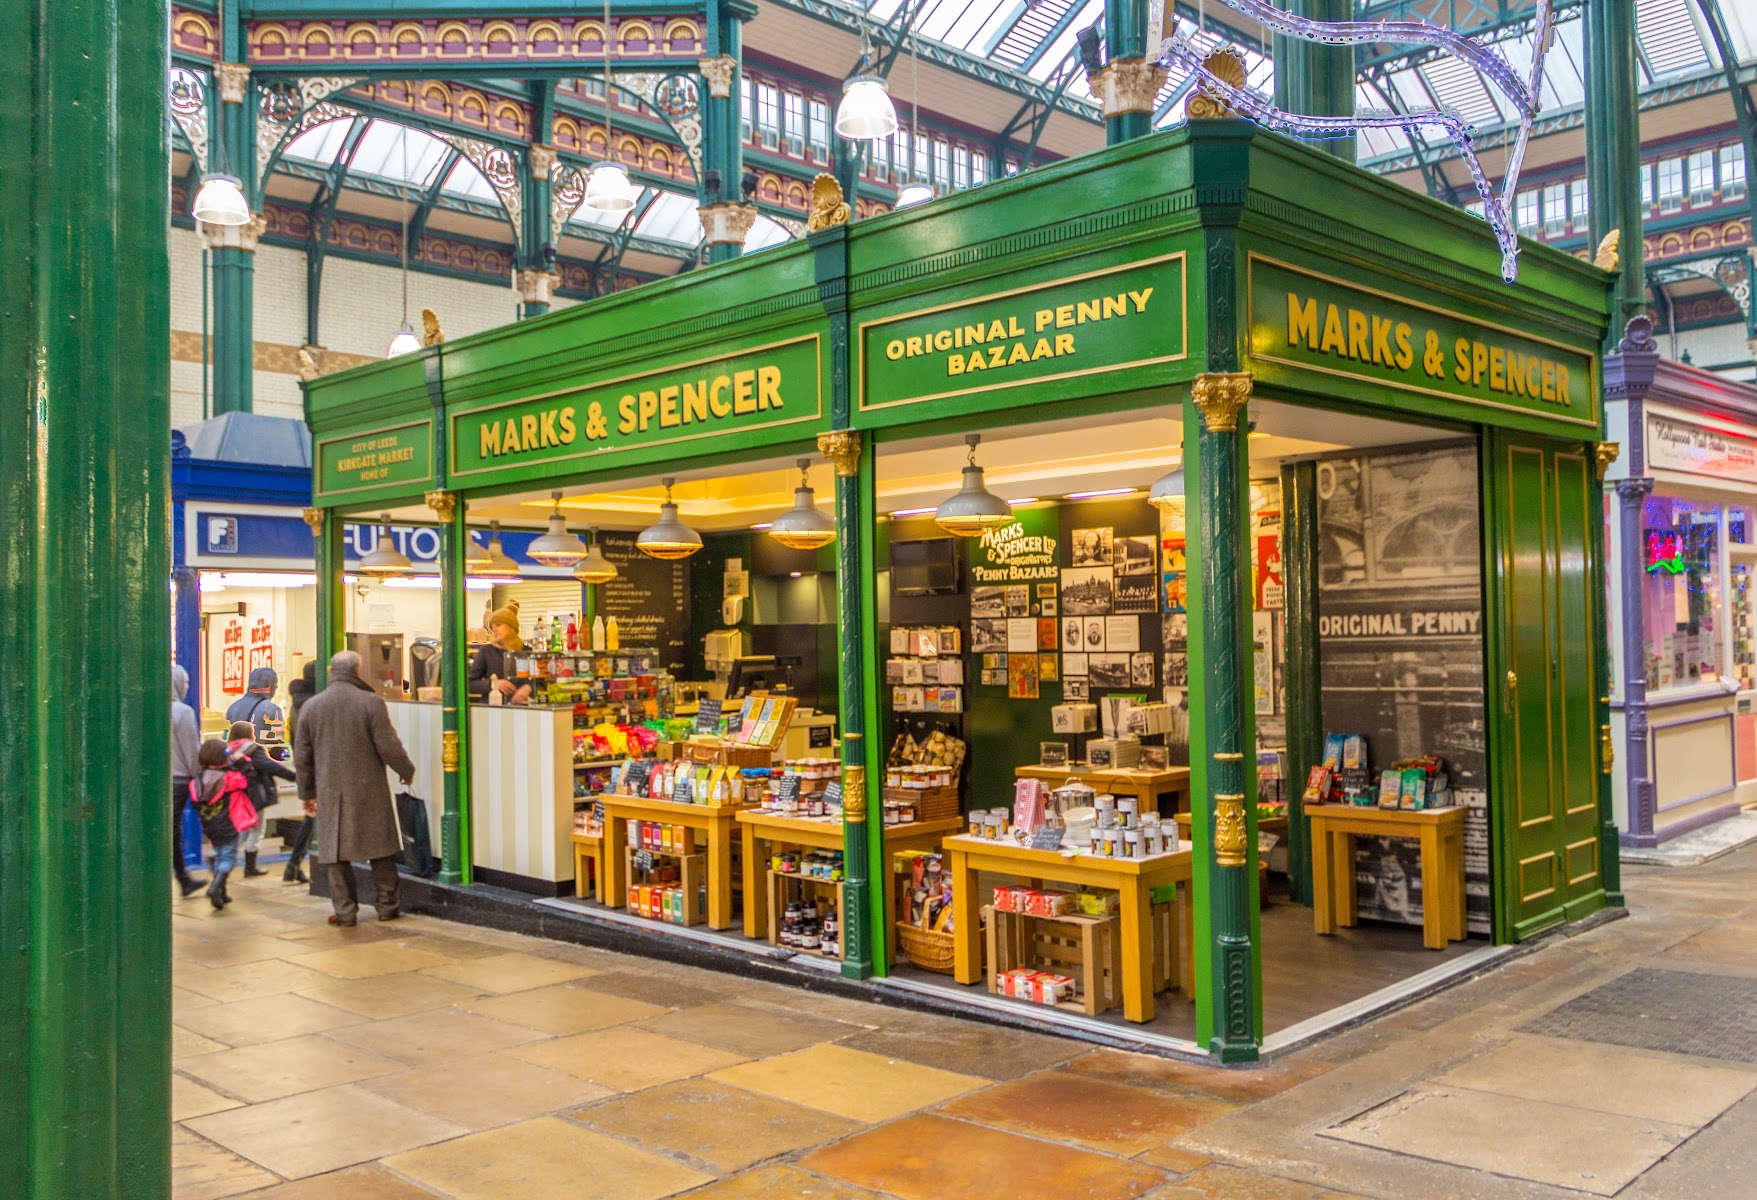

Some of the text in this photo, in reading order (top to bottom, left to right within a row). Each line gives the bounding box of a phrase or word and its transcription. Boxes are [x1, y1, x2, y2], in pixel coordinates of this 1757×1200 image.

[886, 287, 1154, 361] ORIGINAL PENNY
[947, 333, 1076, 376] BAZAAR
[1287, 292, 1571, 406] MARKS & SPENCER
[480, 365, 784, 459] MARKS & SPENCER
[352, 436, 397, 454] CITY OF LEEDS
[337, 446, 414, 472] KIRKGATE MARKET
[360, 468, 389, 481] HOME OF
[980, 522, 1024, 548] MARKS
[987, 549, 996, 562] &
[996, 536, 1042, 564] SPENCER
[975, 566, 1009, 581] PENNY
[1010, 566, 1058, 580] BAZAARS
[1320, 610, 1480, 636] ORIGINAL PENNY
[224, 648, 242, 680] BIG
